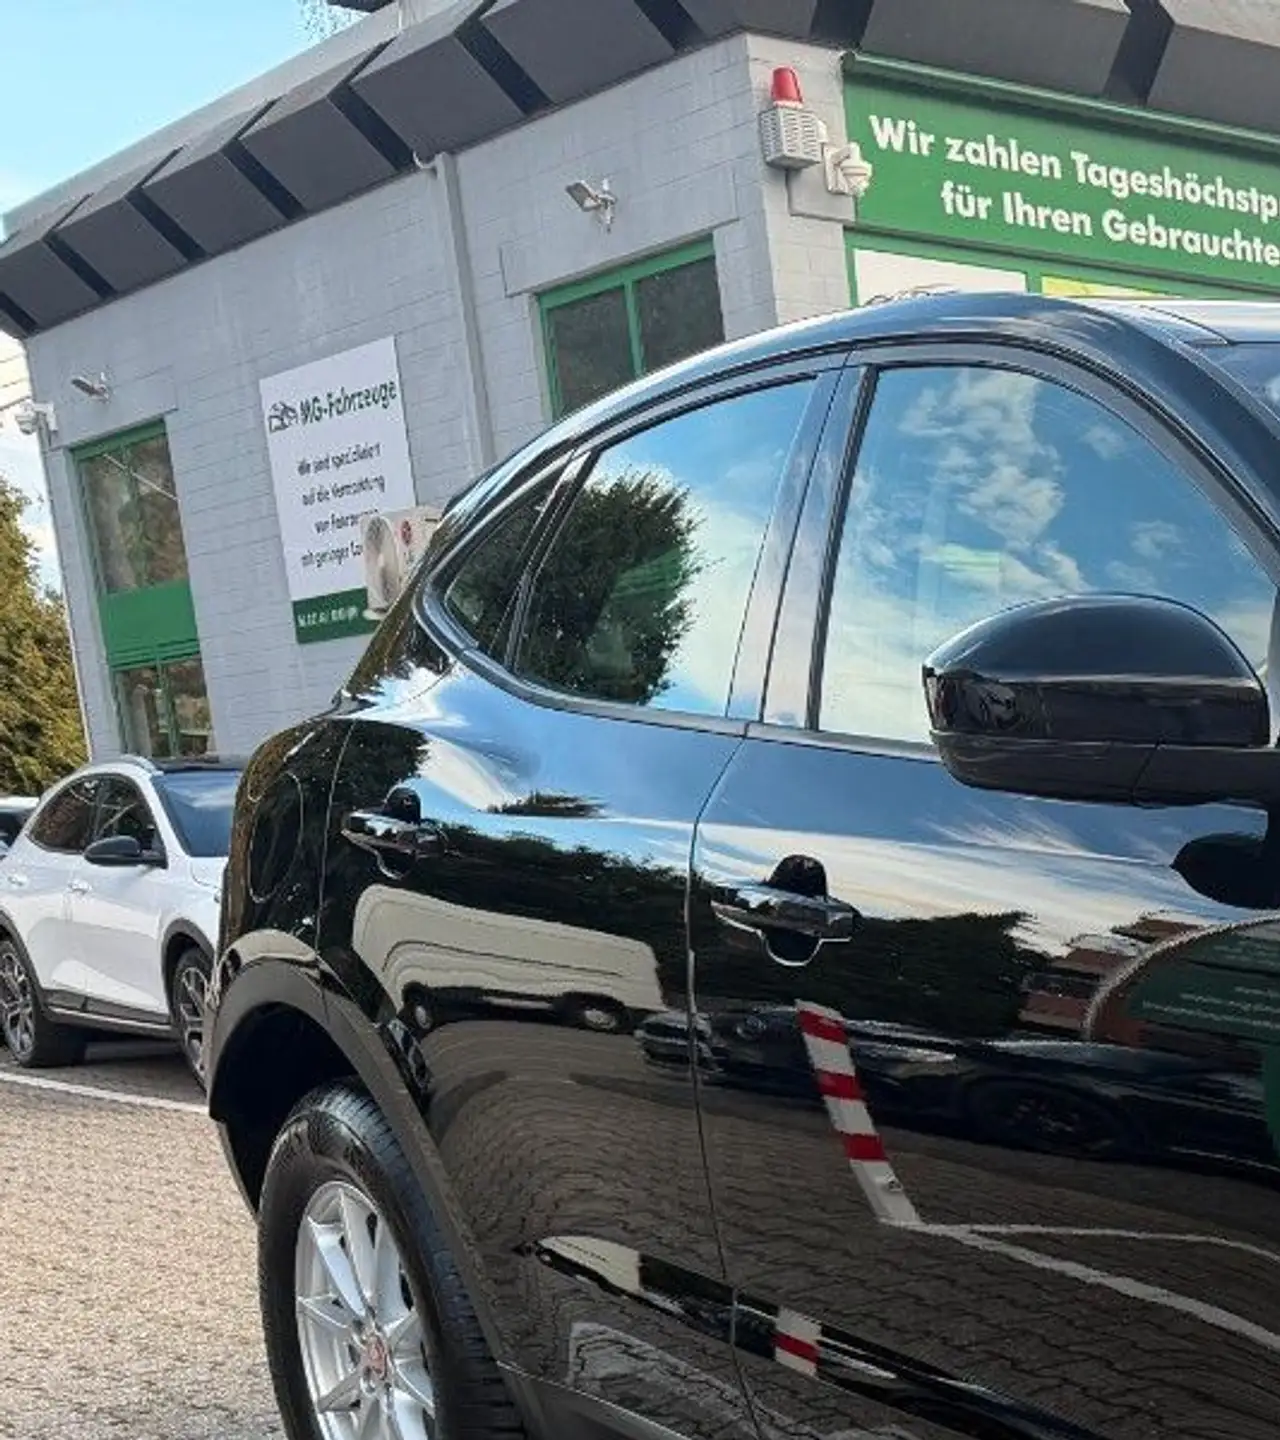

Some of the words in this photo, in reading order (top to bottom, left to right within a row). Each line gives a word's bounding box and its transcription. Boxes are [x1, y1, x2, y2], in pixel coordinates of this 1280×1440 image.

[868, 114, 936, 157] Wir
[944, 133, 1062, 180] zahlen
[940, 179, 993, 220] für
[1002, 191, 1093, 236] Ihren
